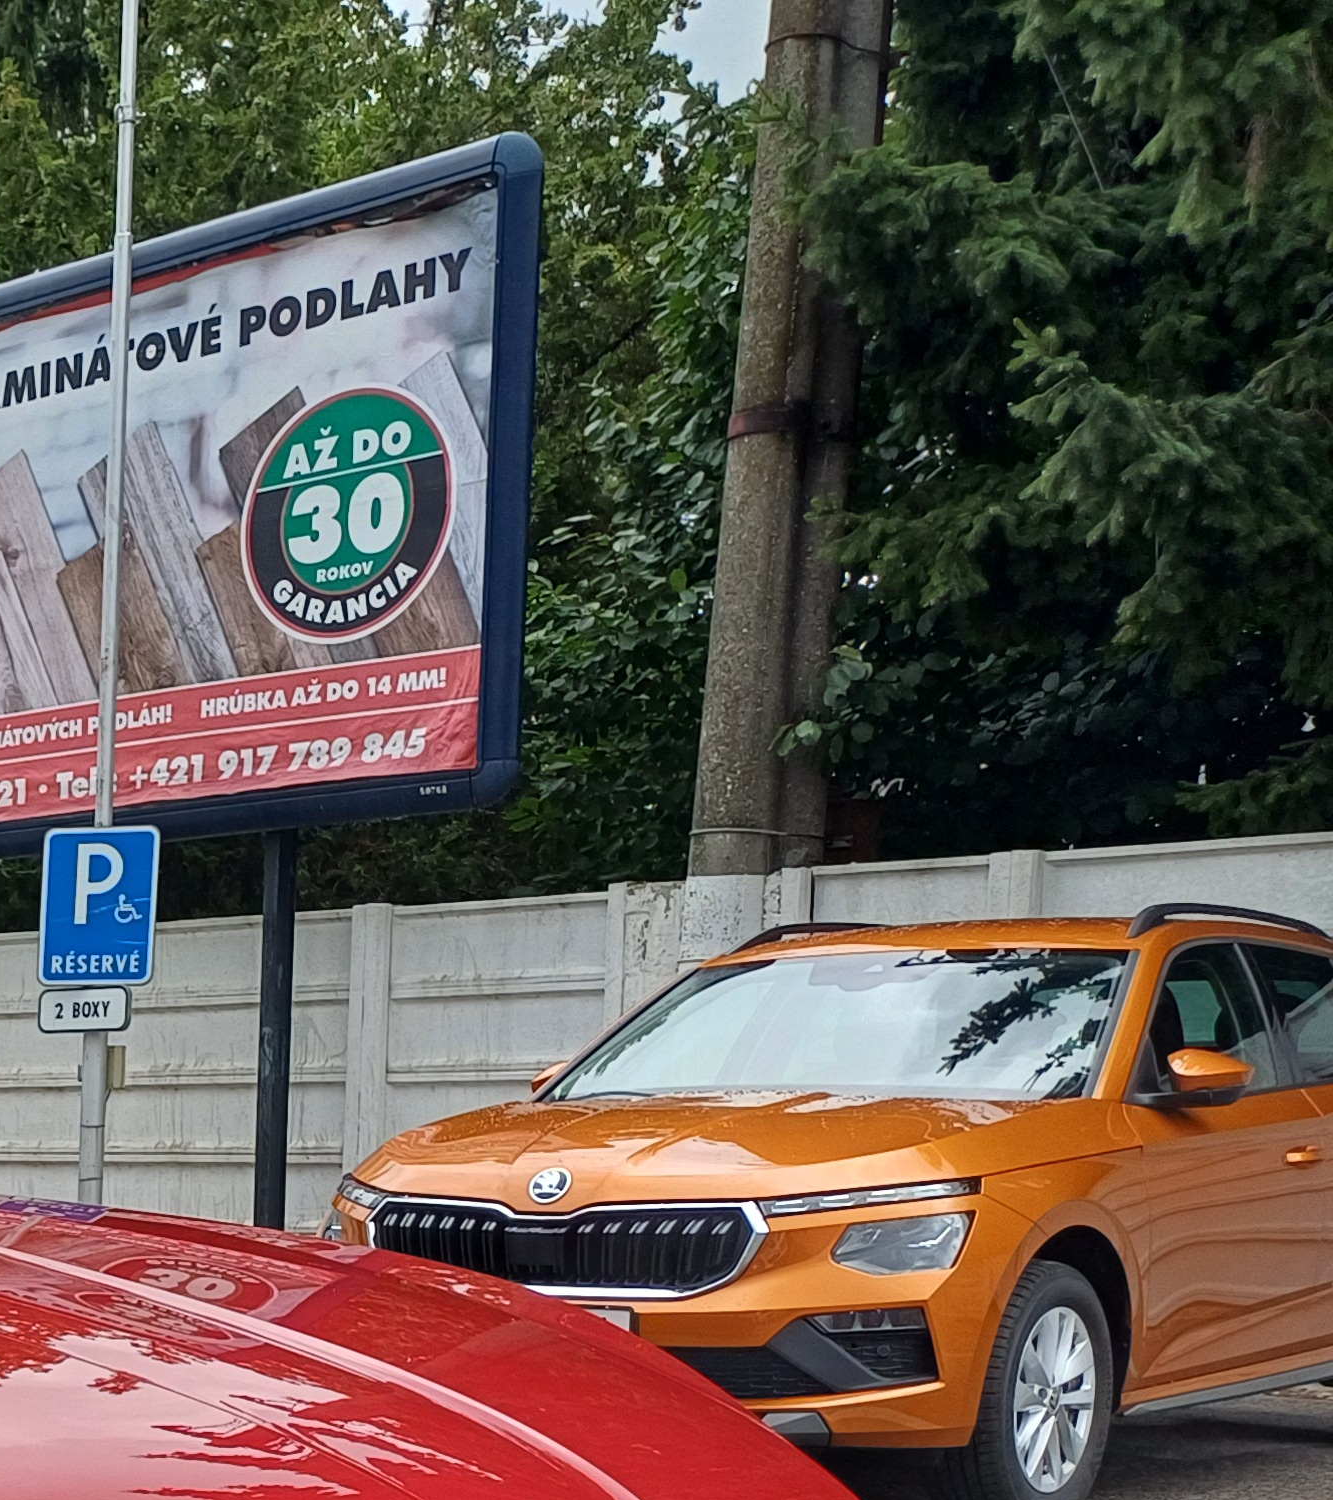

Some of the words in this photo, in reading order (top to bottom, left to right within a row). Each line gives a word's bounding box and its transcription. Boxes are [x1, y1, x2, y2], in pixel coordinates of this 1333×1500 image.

[239, 246, 473, 347] PODLAHY
[283, 425, 339, 479] AŽ
[352, 420, 412, 464] DO
[288, 471, 405, 565] 30
[272, 561, 418, 625] GARANCIA
[316, 560, 374, 583] ROKOV
[87, 701, 173, 736] PDLÁH!
[200, 688, 287, 719] HRÚBKA
[290, 676, 322, 706] AŽ
[326, 679, 359, 702] DO
[366, 675, 392, 697] 14
[396, 667, 448, 693] MM!
[129, 753, 205, 790] +421
[217, 743, 279, 780] 917
[286, 736, 352, 772] 789
[360, 726, 429, 764] 845
[74, 842, 124, 925] P
[50, 949, 140, 974] RÉSERVÉ
[54, 1002, 64, 1020] 2
[71, 1000, 111, 1019] BOXY
